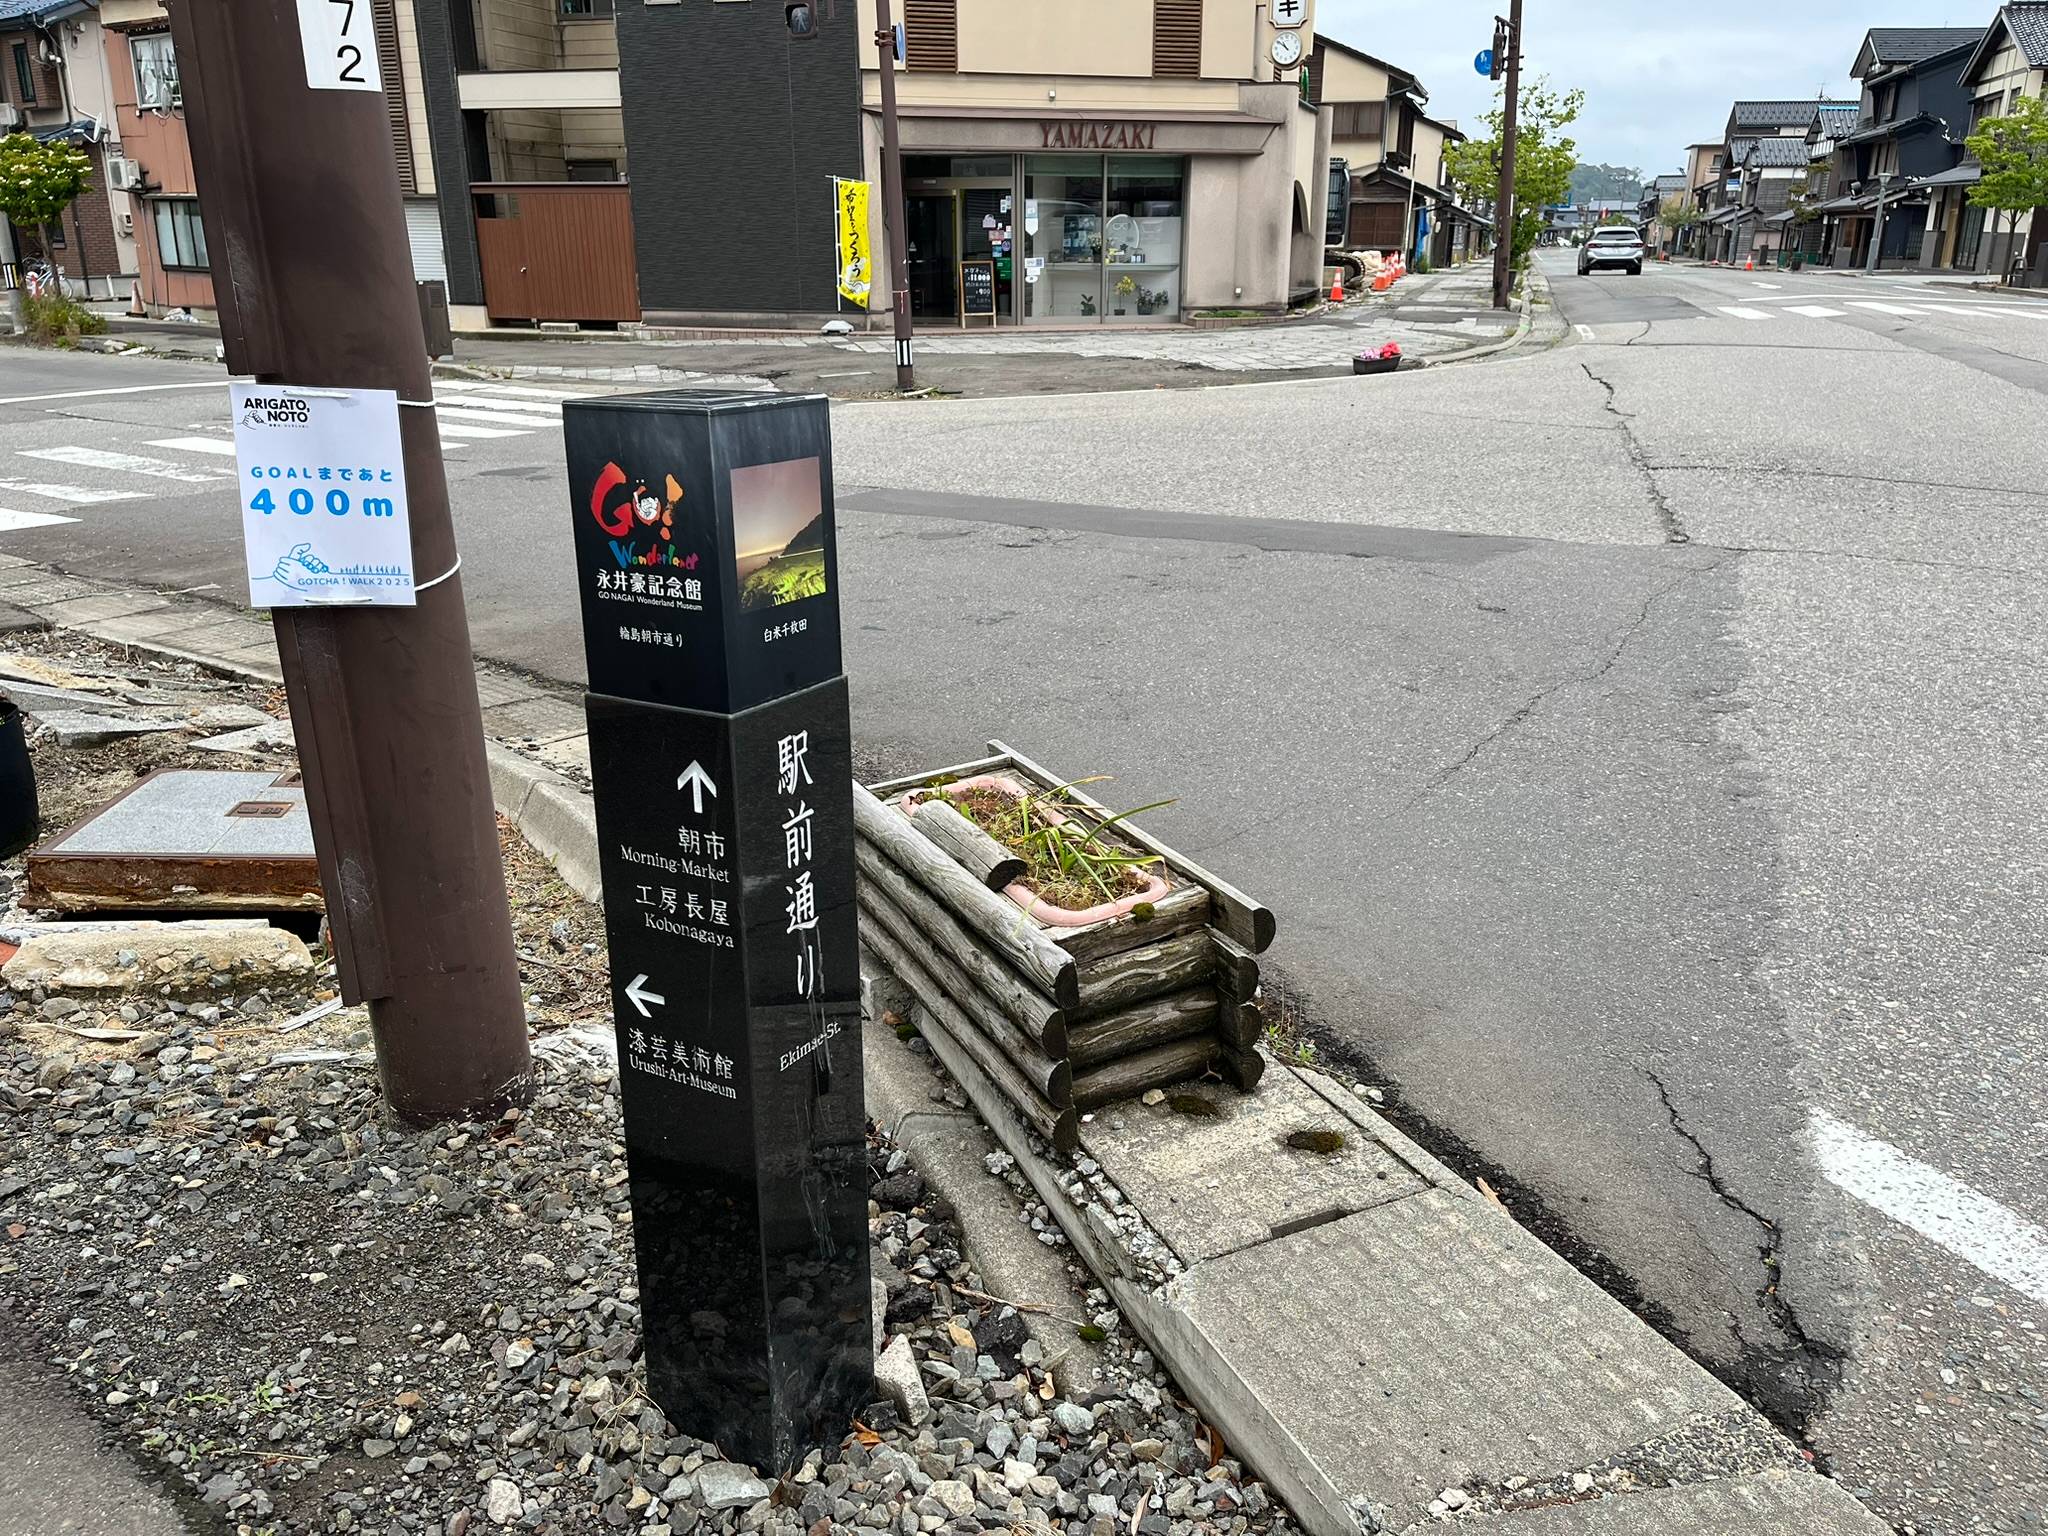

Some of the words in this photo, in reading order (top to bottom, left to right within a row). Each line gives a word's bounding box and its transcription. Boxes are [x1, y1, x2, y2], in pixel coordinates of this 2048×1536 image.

[1040, 123, 1156, 149] YAMAZAKI
[244, 398, 310, 412] ARIGATO,
[267, 410, 308, 423] NOTO
[251, 466, 392, 482] GOALまであと
[250, 488, 393, 517] 400m
[608, 540, 699, 569] Wonderland
[597, 568, 702, 601] 永井豪記念館
[598, 591, 610, 600] GO
[611, 592, 635, 603] NAGAI
[636, 595, 675, 609] Wonderland
[677, 600, 703, 611] Museum
[619, 626, 683, 648] 輪島朝市通り
[763, 618, 807, 643] 白米千枚田
[678, 825, 725, 860] 朝市
[620, 844, 730, 883] Morning-Market
[777, 729, 820, 999] 駅前通り
[635, 884, 730, 926] 工房長屋
[644, 911, 734, 948] Kobonagaya
[628, 1027, 734, 1079] 漆芸美術館
[629, 1053, 737, 1099] Urushi-Art-Museum
